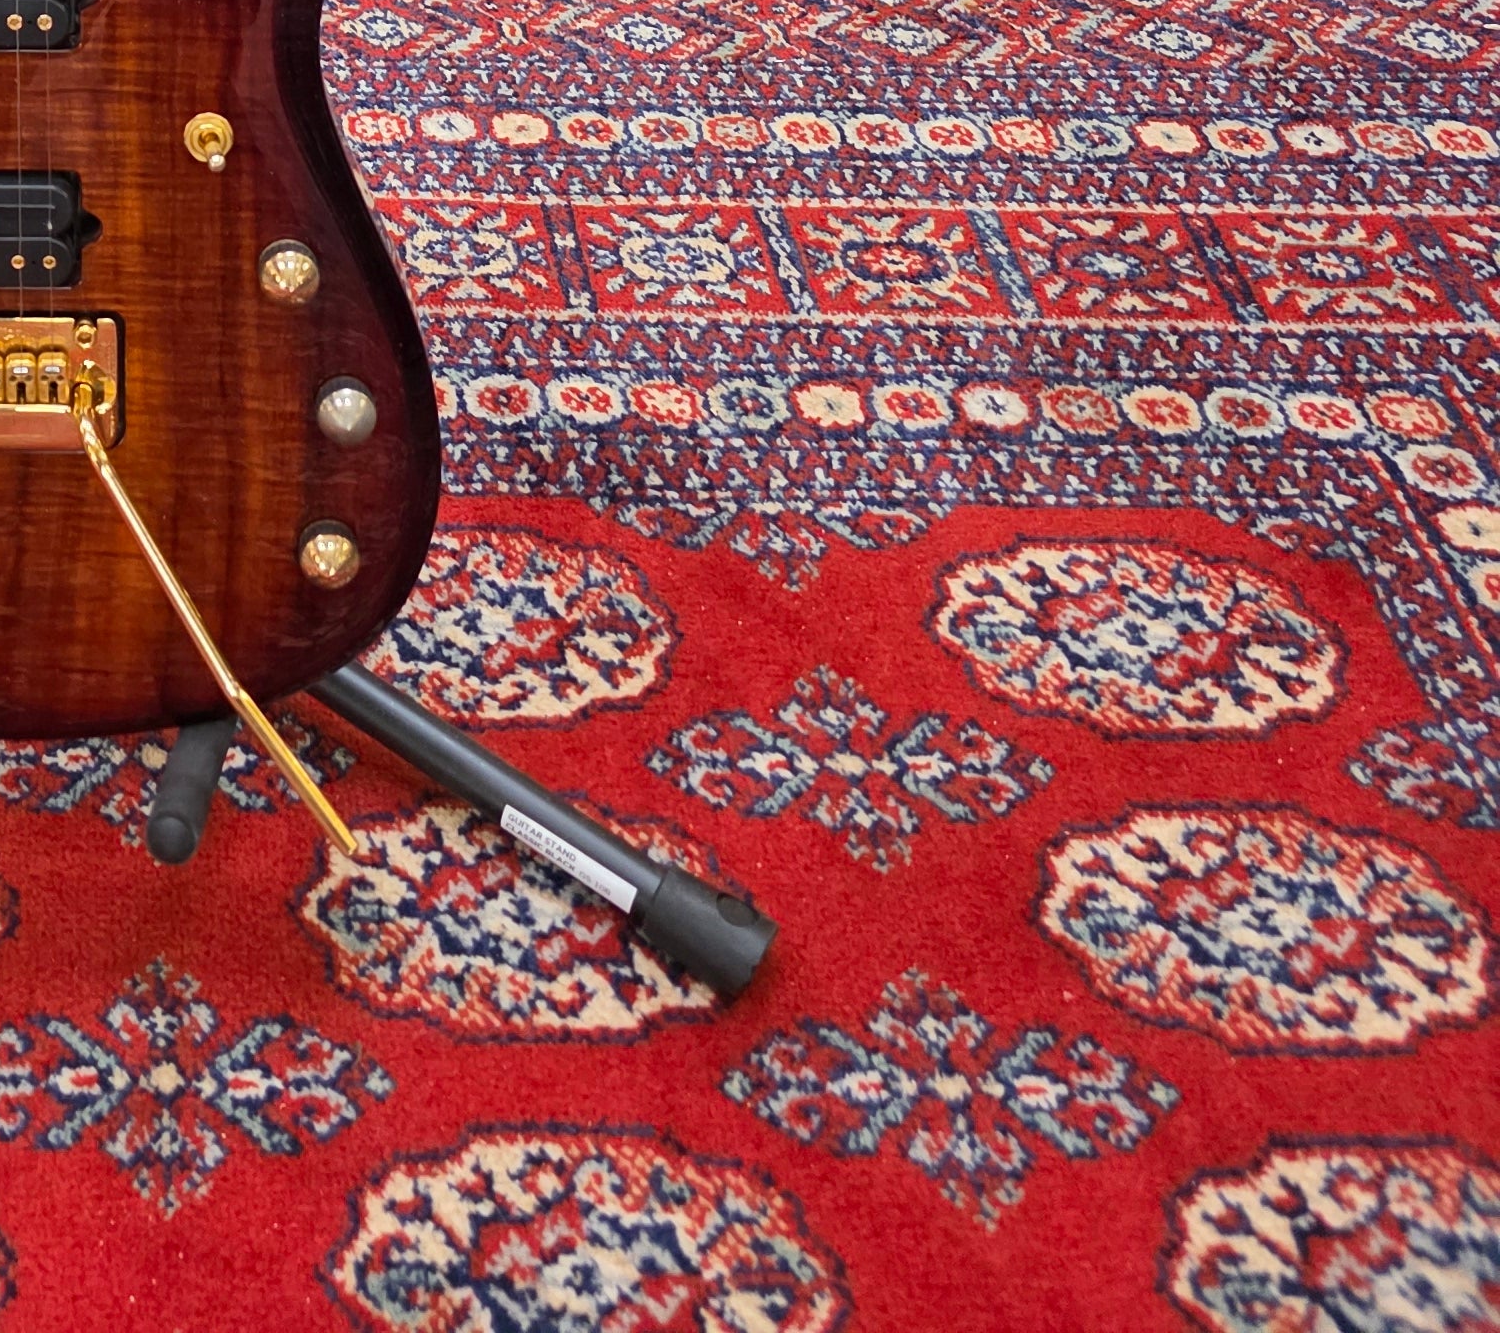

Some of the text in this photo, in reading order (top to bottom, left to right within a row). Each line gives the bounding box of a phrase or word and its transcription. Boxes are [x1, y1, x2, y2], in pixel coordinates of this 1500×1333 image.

[505, 823, 543, 850] CLASSIC
[545, 848, 576, 871] BLACK
[507, 813, 577, 863] GUITAR STAND
